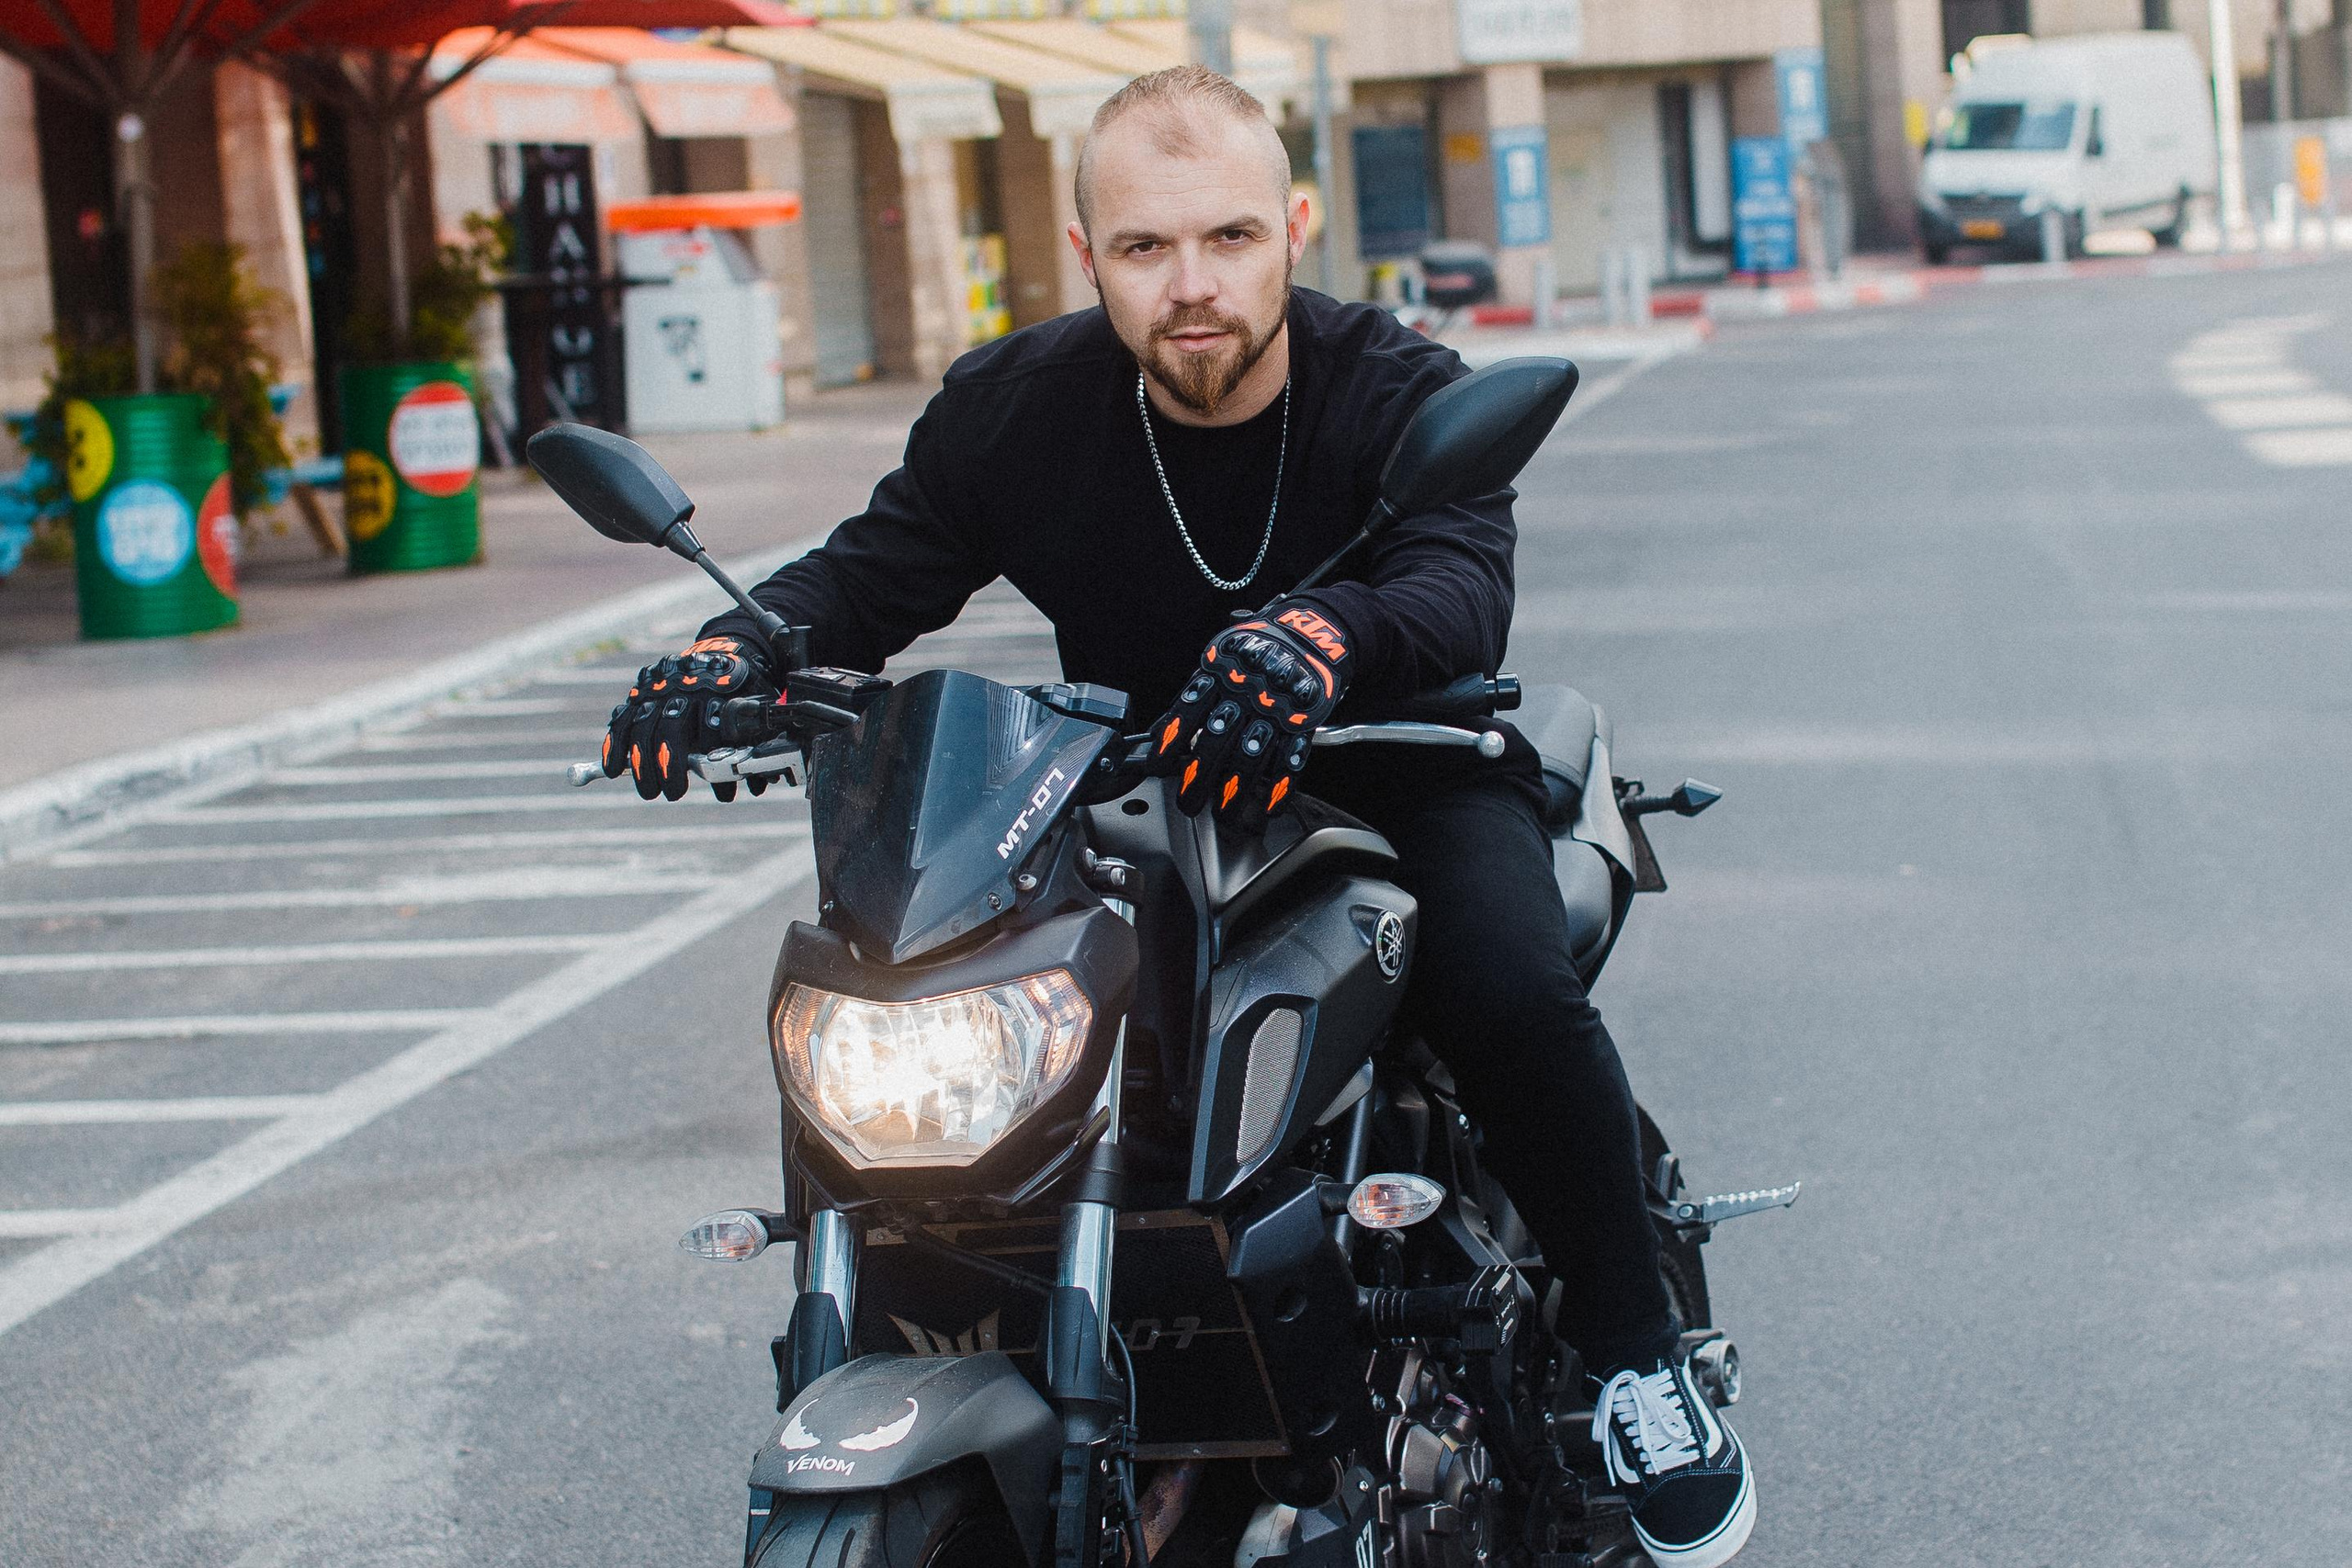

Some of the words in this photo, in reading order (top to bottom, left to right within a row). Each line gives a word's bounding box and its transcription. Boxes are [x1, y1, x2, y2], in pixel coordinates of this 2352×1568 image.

[1278, 610, 1346, 660] KTM
[997, 767, 1065, 860] MT-07
[787, 1452, 855, 1476] VENOM
